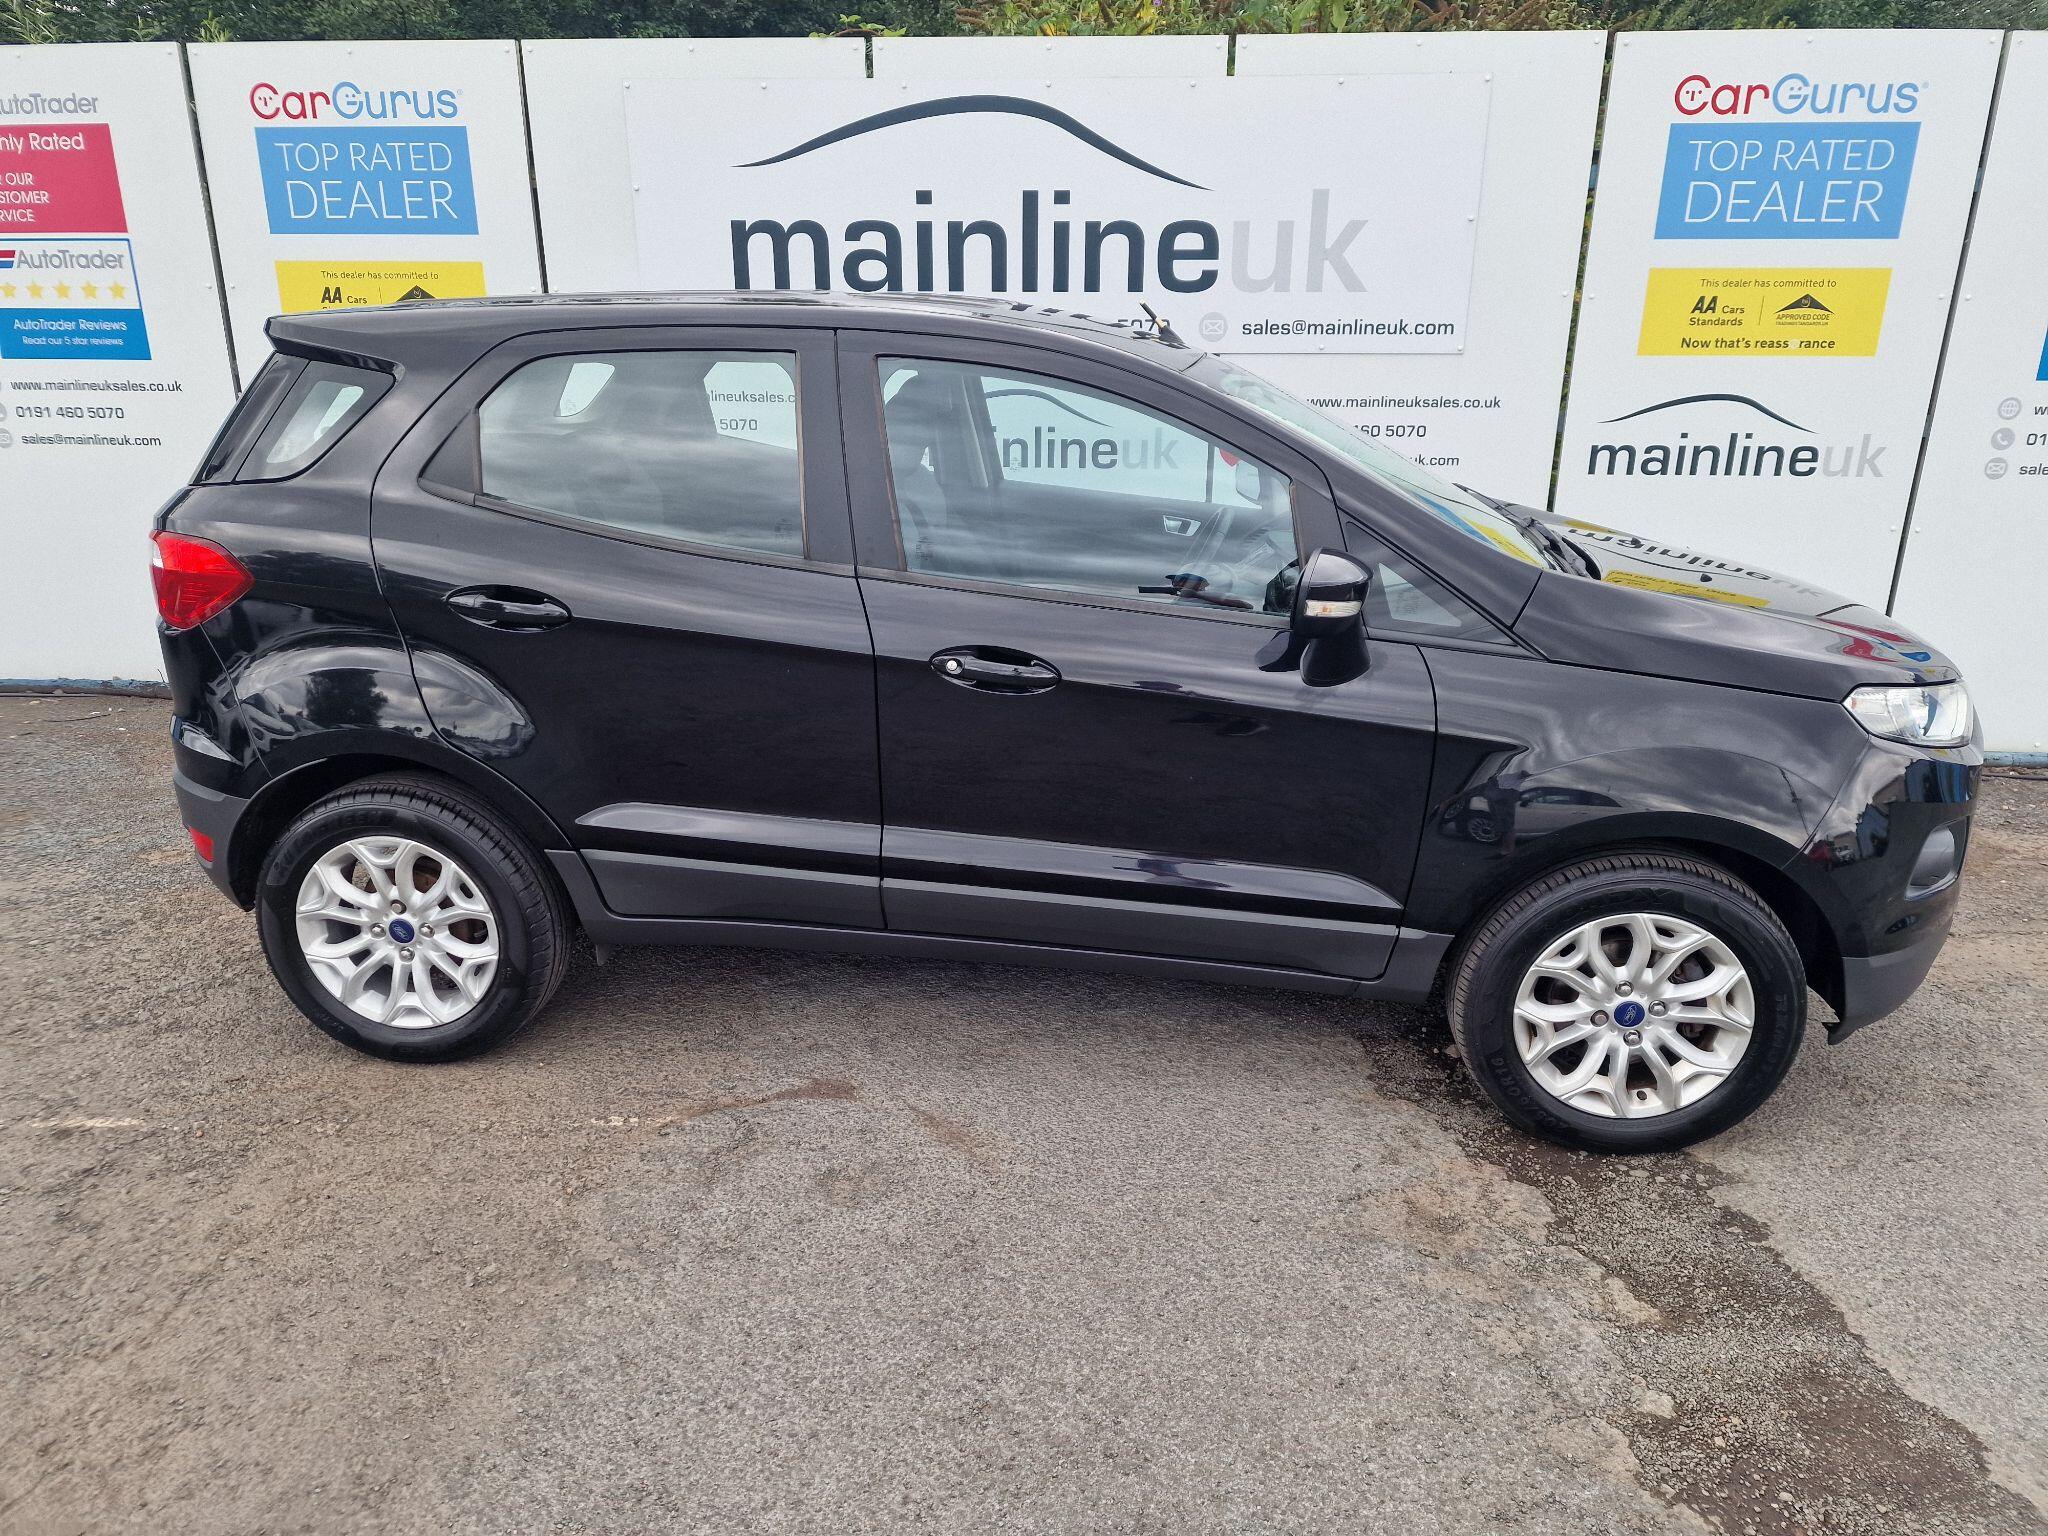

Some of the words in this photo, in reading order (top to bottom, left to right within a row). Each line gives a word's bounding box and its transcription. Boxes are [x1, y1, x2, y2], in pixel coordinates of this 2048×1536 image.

[249, 81, 458, 119] CarGurus
[1674, 73, 1920, 116] CarGurus
[0, 93, 98, 115] utoTrader
[28, 132, 85, 150] Rated
[273, 142, 339, 171] TOP
[349, 142, 452, 171] RATED
[1688, 139, 1764, 172] TOP
[1772, 139, 1895, 171] RATED
[5, 172, 34, 185] OUR
[286, 180, 458, 219] DEALER
[1684, 181, 1885, 222] DEALER
[730, 189, 1369, 293] mainlineuk
[17, 249, 124, 269] AutoTrader
[320, 270, 338, 279] This
[340, 270, 366, 279] dealer
[367, 270, 382, 279] has
[384, 271, 428, 280] committed
[430, 271, 439, 280] to
[1700, 279, 1720, 288] This
[1722, 279, 1752, 288] dealer
[1754, 279, 1771, 288] has
[1773, 279, 1825, 288] committed
[1827, 280, 1837, 288] to
[321, 286, 342, 303] AA
[347, 296, 367, 304] Cars
[1691, 295, 1718, 314] AA
[1722, 305, 1745, 314] Cars
[13, 318, 76, 331] AutoTrader
[78, 318, 128, 331] Reviews
[1241, 318, 1455, 336] sales@mainlineuk.com
[1689, 317, 1743, 326] Standards
[22, 336, 46, 345] Read
[47, 337, 62, 345] our
[64, 336, 70, 345] 5
[1681, 338, 1711, 348] Now
[1754, 339, 1836, 349] reassrance
[10, 379, 183, 392] www.mainlineuksales.co.uk
[15, 406, 52, 418] 0191
[55, 406, 84, 419] 460
[86, 407, 125, 419] 5070
[719, 418, 758, 431] 5070
[1353, 424, 1381, 437] 60
[1385, 424, 1427, 437] 5070
[21, 433, 162, 446] sales@mainlineuk.com
[993, 426, 1179, 470] nlineuk
[1588, 432, 1887, 477] mainlineuk
